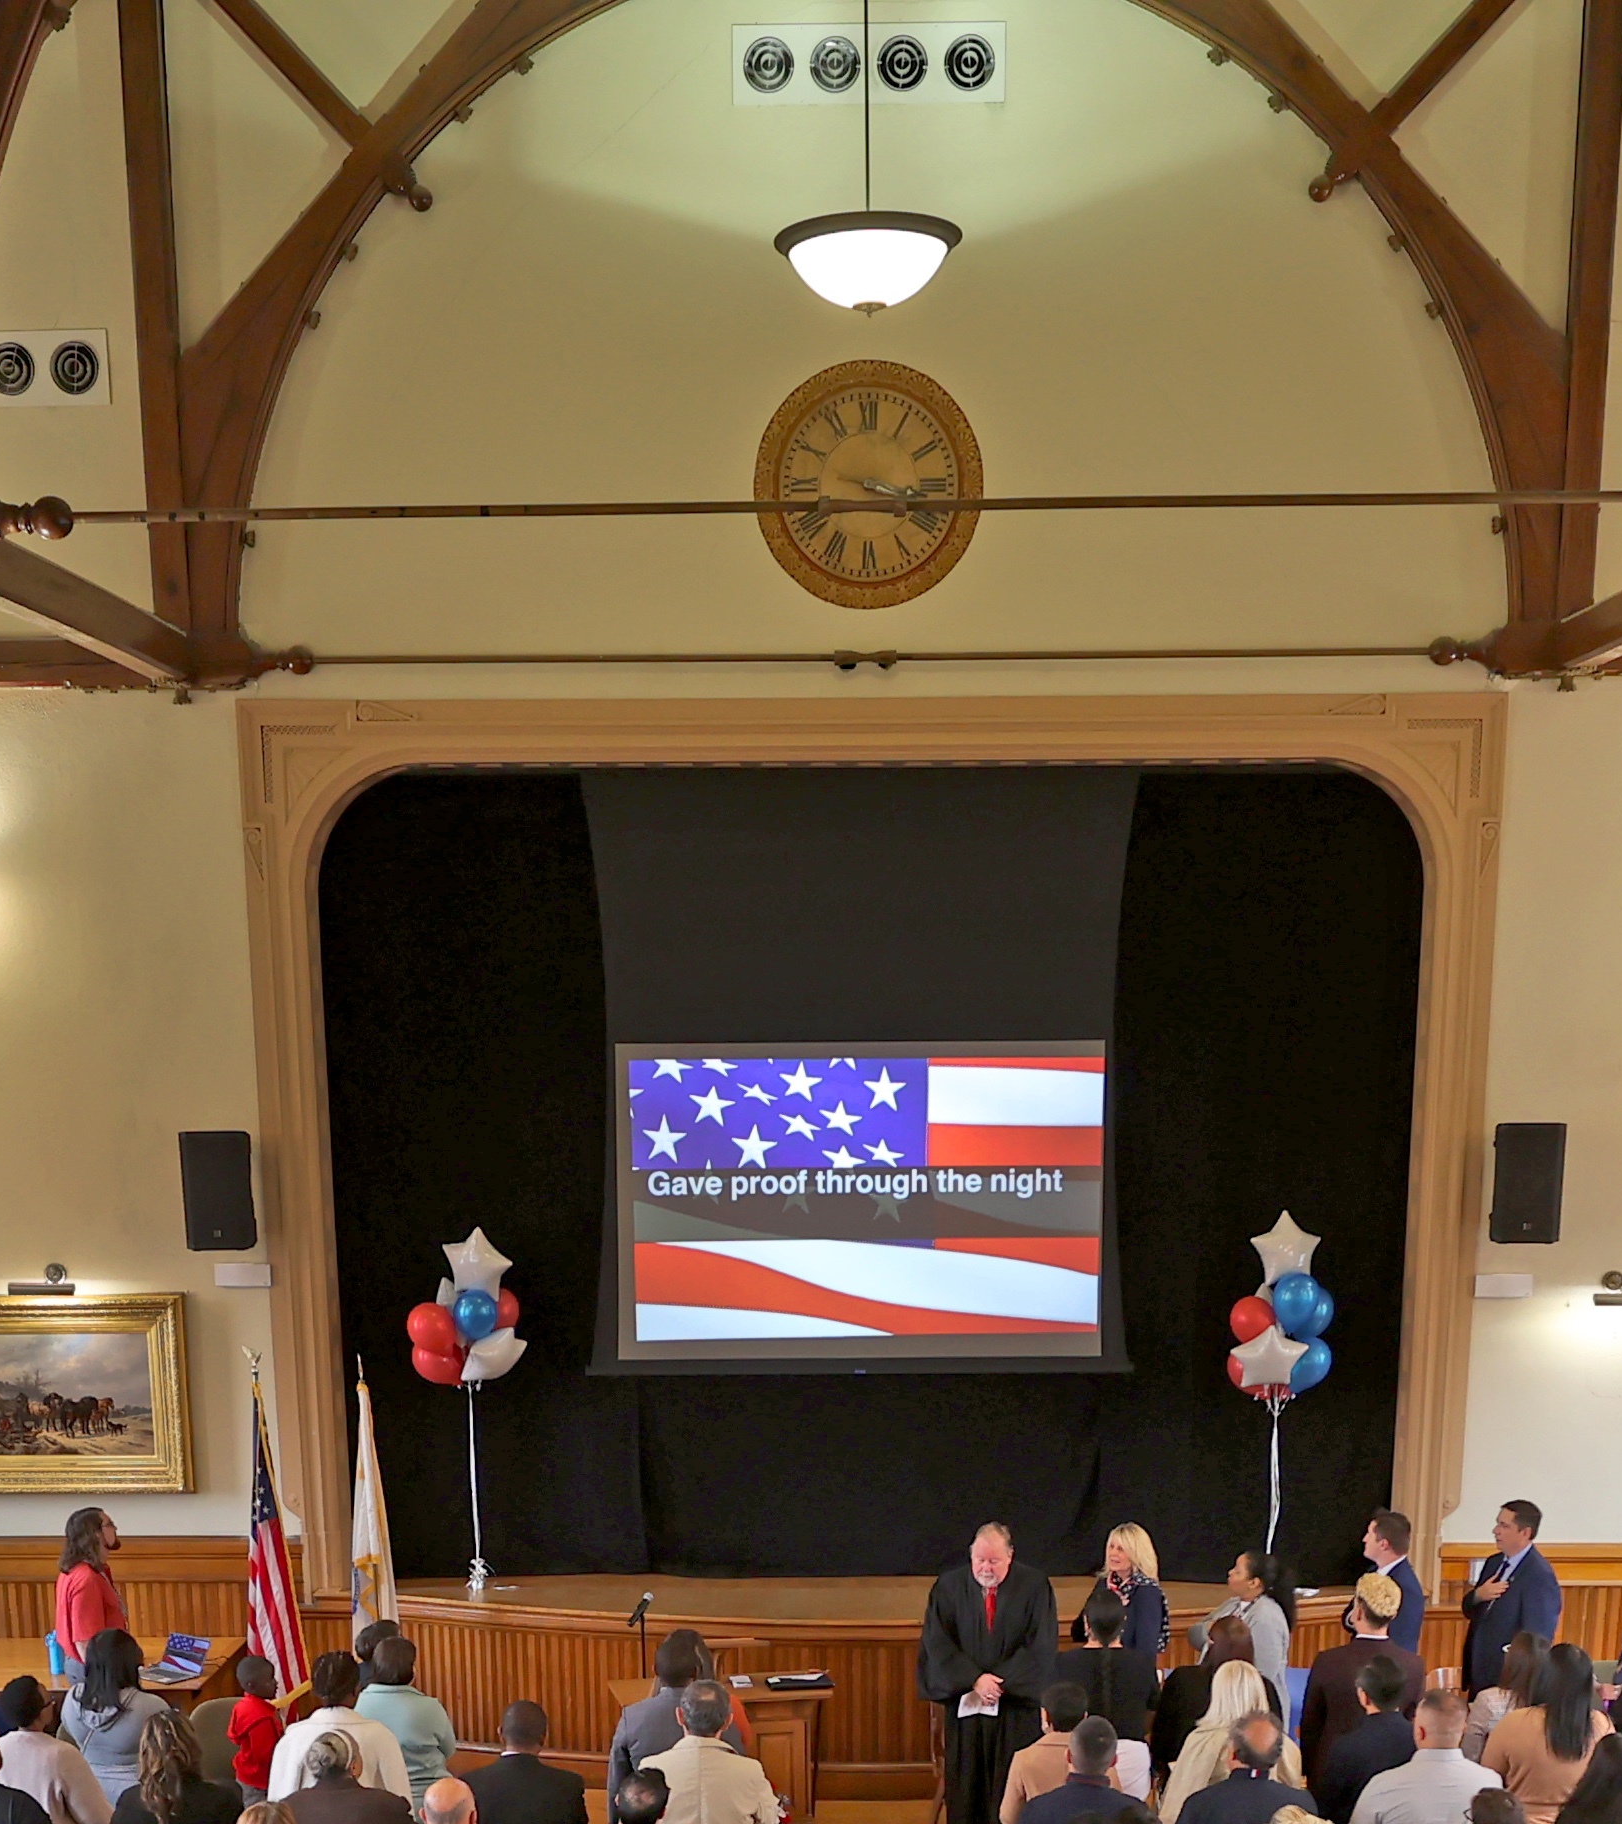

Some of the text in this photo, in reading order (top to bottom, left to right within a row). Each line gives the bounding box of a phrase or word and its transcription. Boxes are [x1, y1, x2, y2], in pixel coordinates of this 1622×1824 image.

[859, 401, 879, 431] XII
[893, 411, 910, 440] I
[801, 442, 828, 461] X
[912, 439, 939, 462] II
[647, 1168, 1063, 1201] Gave proof through the night
